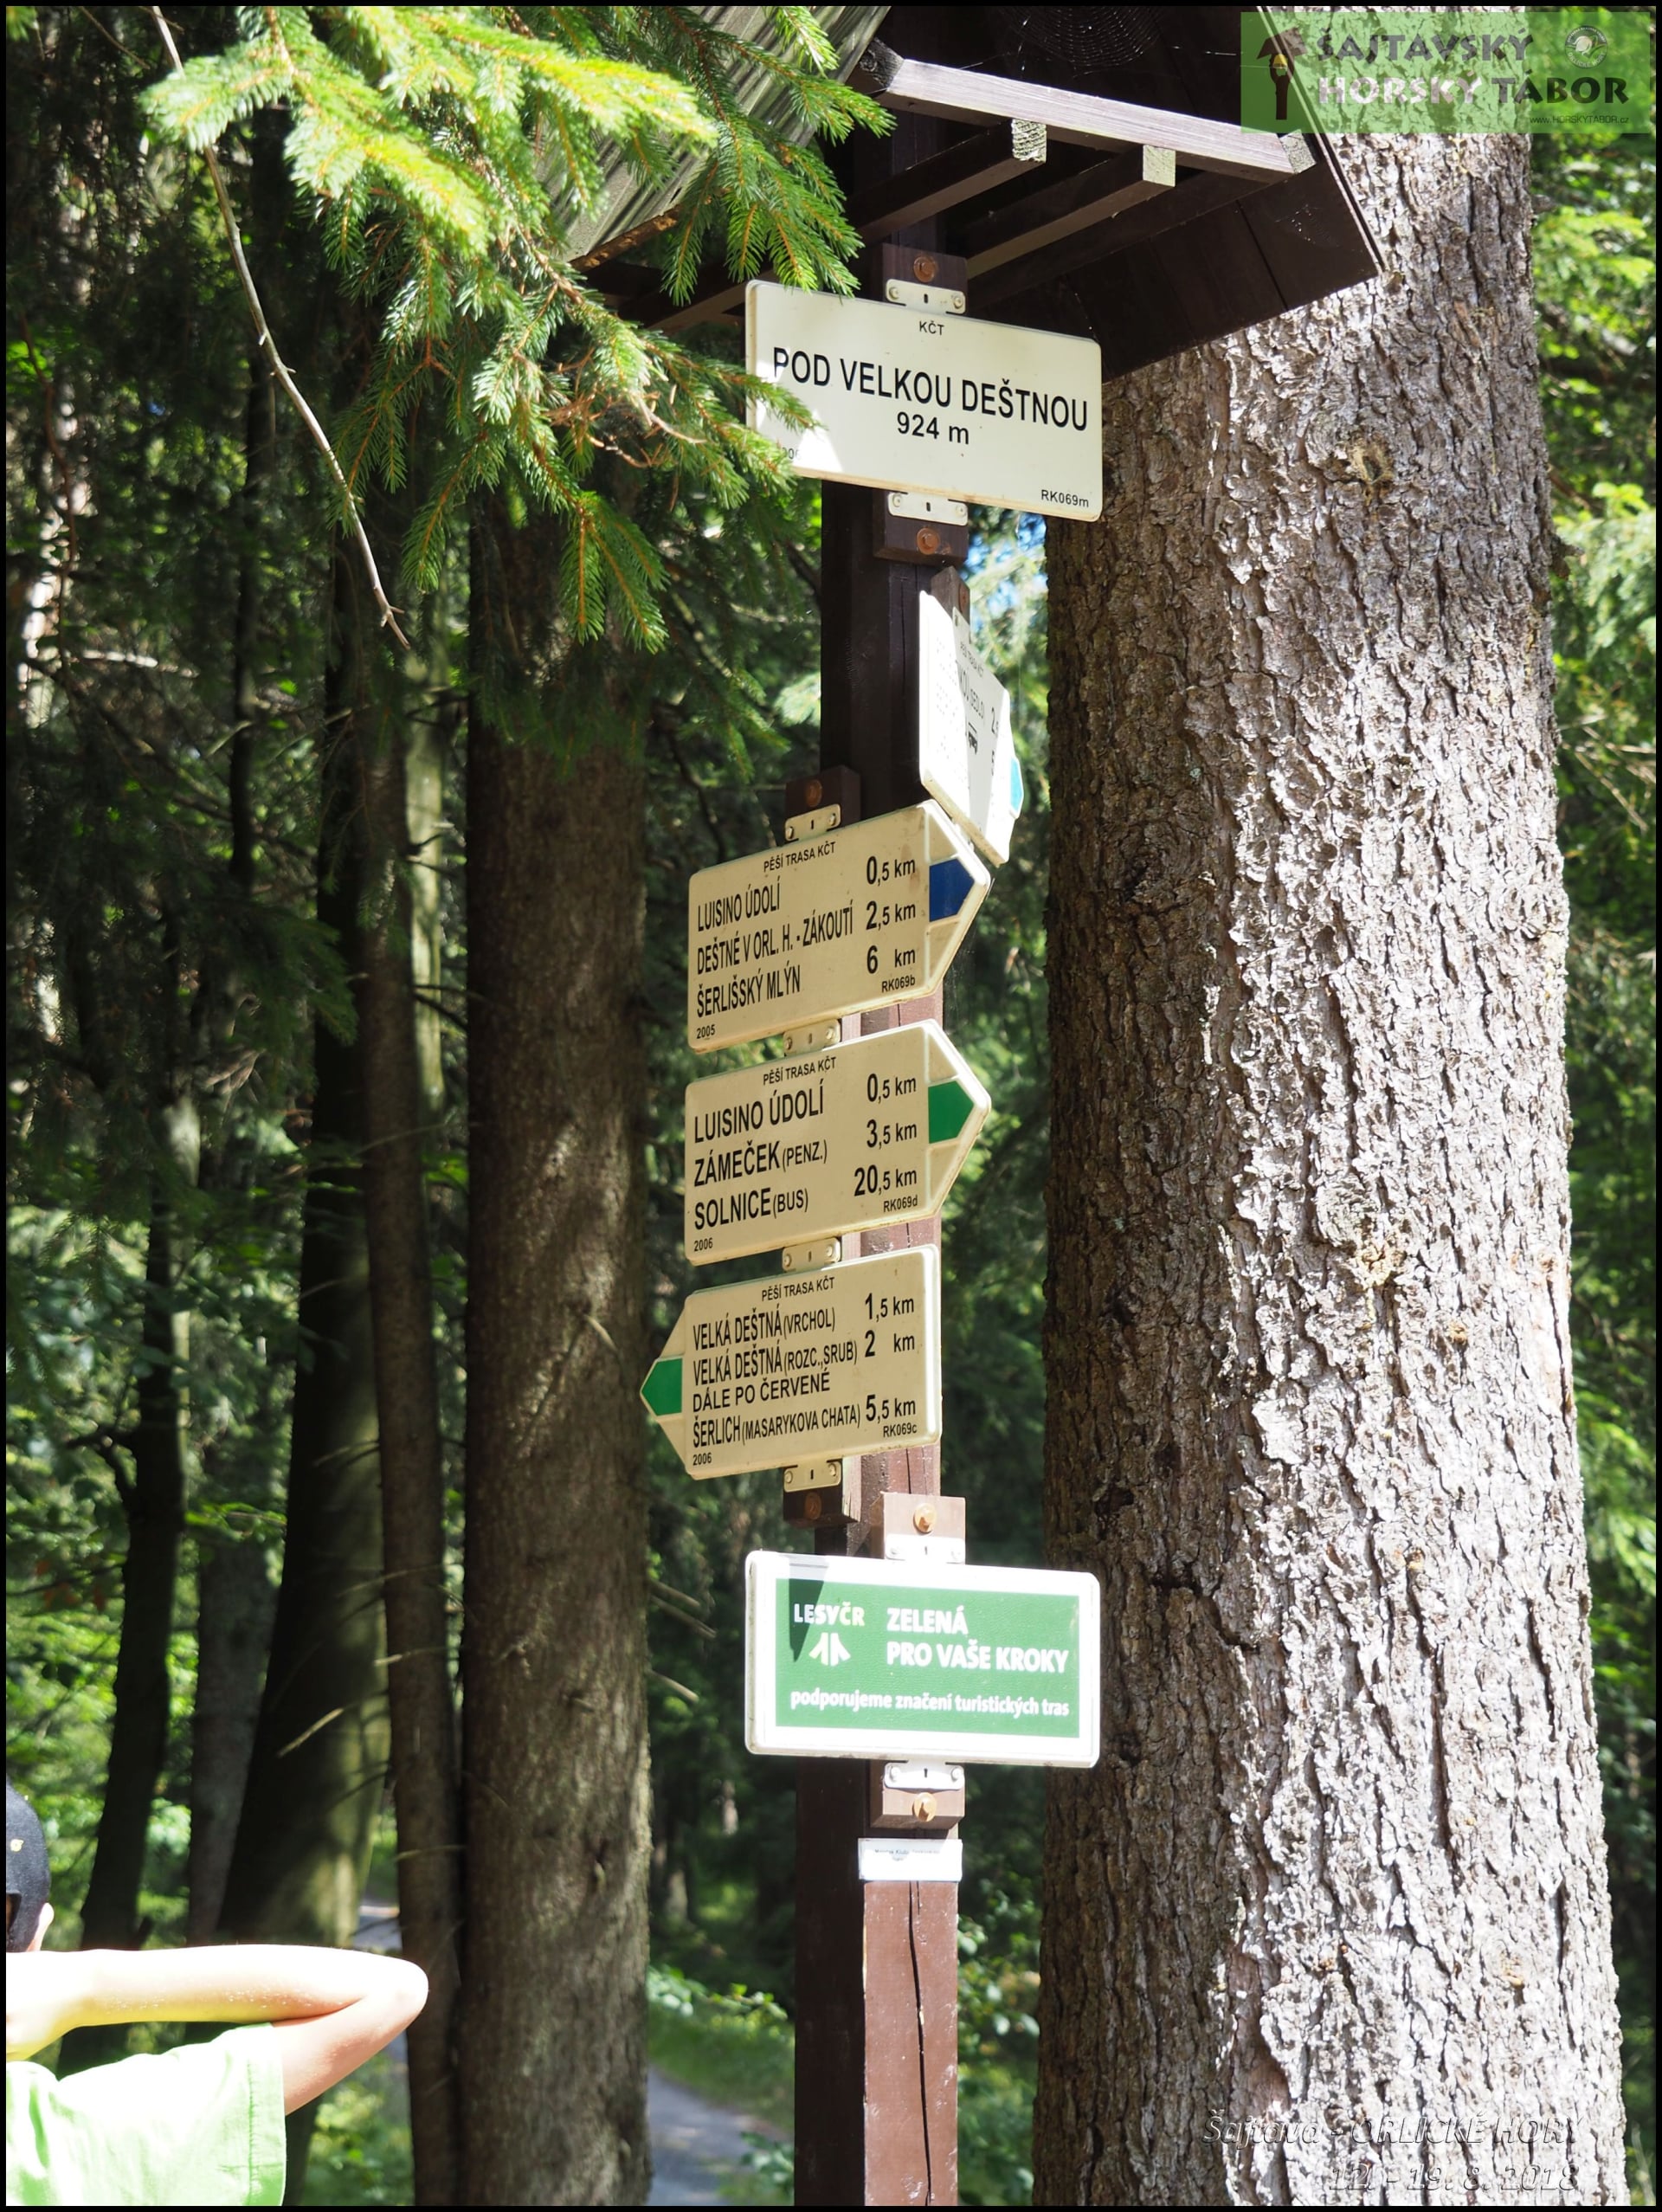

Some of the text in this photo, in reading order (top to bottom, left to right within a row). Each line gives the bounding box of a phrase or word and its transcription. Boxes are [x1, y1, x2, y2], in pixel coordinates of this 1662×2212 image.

[919, 321, 945, 335] KČT
[774, 347, 1088, 431] POD VELKOU DEŠTNOU
[898, 412, 970, 444] 924 m
[1041, 489, 1090, 507] RK069m
[763, 842, 836, 873] PĚŠÍ TRASA KČT
[699, 856, 916, 932] LUISINO ÚDOLÍ 0,5 km
[698, 931, 740, 975] DEŠTNÉ
[743, 938, 751, 963] V
[754, 930, 780, 960] ORL.
[783, 924, 794, 951] H.
[803, 900, 854, 947] ZÁKOUTÍ
[866, 901, 890, 931] 2,5
[895, 903, 917, 922] km
[698, 945, 916, 1018] ŠERLIŠSKÝ MLÝN 6 km
[882, 976, 916, 993] RK069b
[697, 1024, 716, 1039] 2005
[763, 1057, 837, 1086] PĚŠÍ TRASA KČT
[695, 1074, 918, 1143] LUISINO ÚDOLÍ 0,5 km
[867, 1119, 891, 1150] 3,5
[896, 1122, 918, 1141] km
[854, 1164, 891, 1196] 20,5
[896, 1169, 918, 1188] km
[883, 1195, 918, 1212] RK069d
[694, 1237, 713, 1252] 2006
[762, 1275, 835, 1301] PĚŠÍ TRASA KČT
[693, 1312, 731, 1351] VELKÁ
[866, 1293, 889, 1322] 1,5
[893, 1295, 915, 1314] km
[693, 1349, 732, 1386] VELKÁ
[866, 1330, 876, 1358] 2
[894, 1333, 916, 1352] km
[693, 1367, 831, 1412] DÁLE PO ČERVENÉ
[821, 1403, 860, 1428] CHATA)
[866, 1395, 890, 1423] 5,5
[894, 1398, 917, 1417] km
[884, 1422, 918, 1438] RK069c
[693, 1453, 712, 1466] 2006
[887, 1605, 969, 1635] ZELENÁ
[887, 1639, 1069, 1674] PRO VAŠE KROKY
[790, 1687, 1070, 1719] podporujeme značení turistických tras
